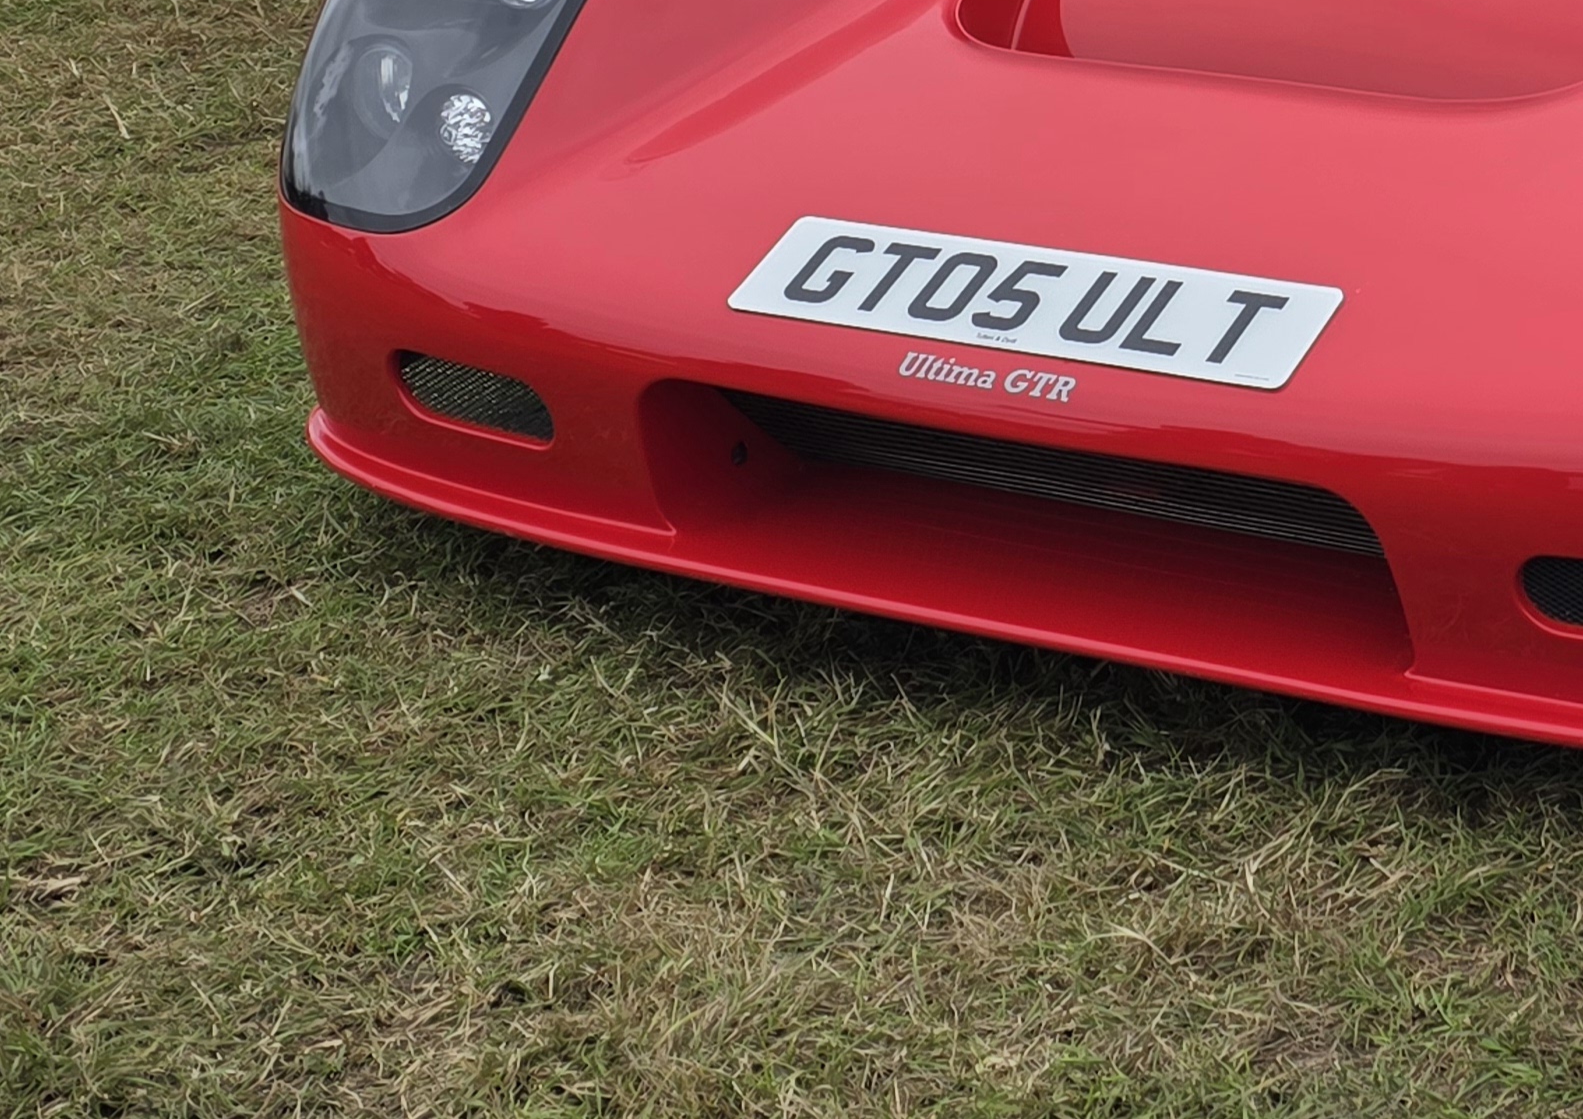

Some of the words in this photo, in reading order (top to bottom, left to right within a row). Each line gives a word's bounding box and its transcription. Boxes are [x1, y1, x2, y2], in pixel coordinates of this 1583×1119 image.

[1058, 271, 1290, 365] ULT
[899, 351, 996, 390] Ultima
[1003, 369, 1077, 403] GTR
